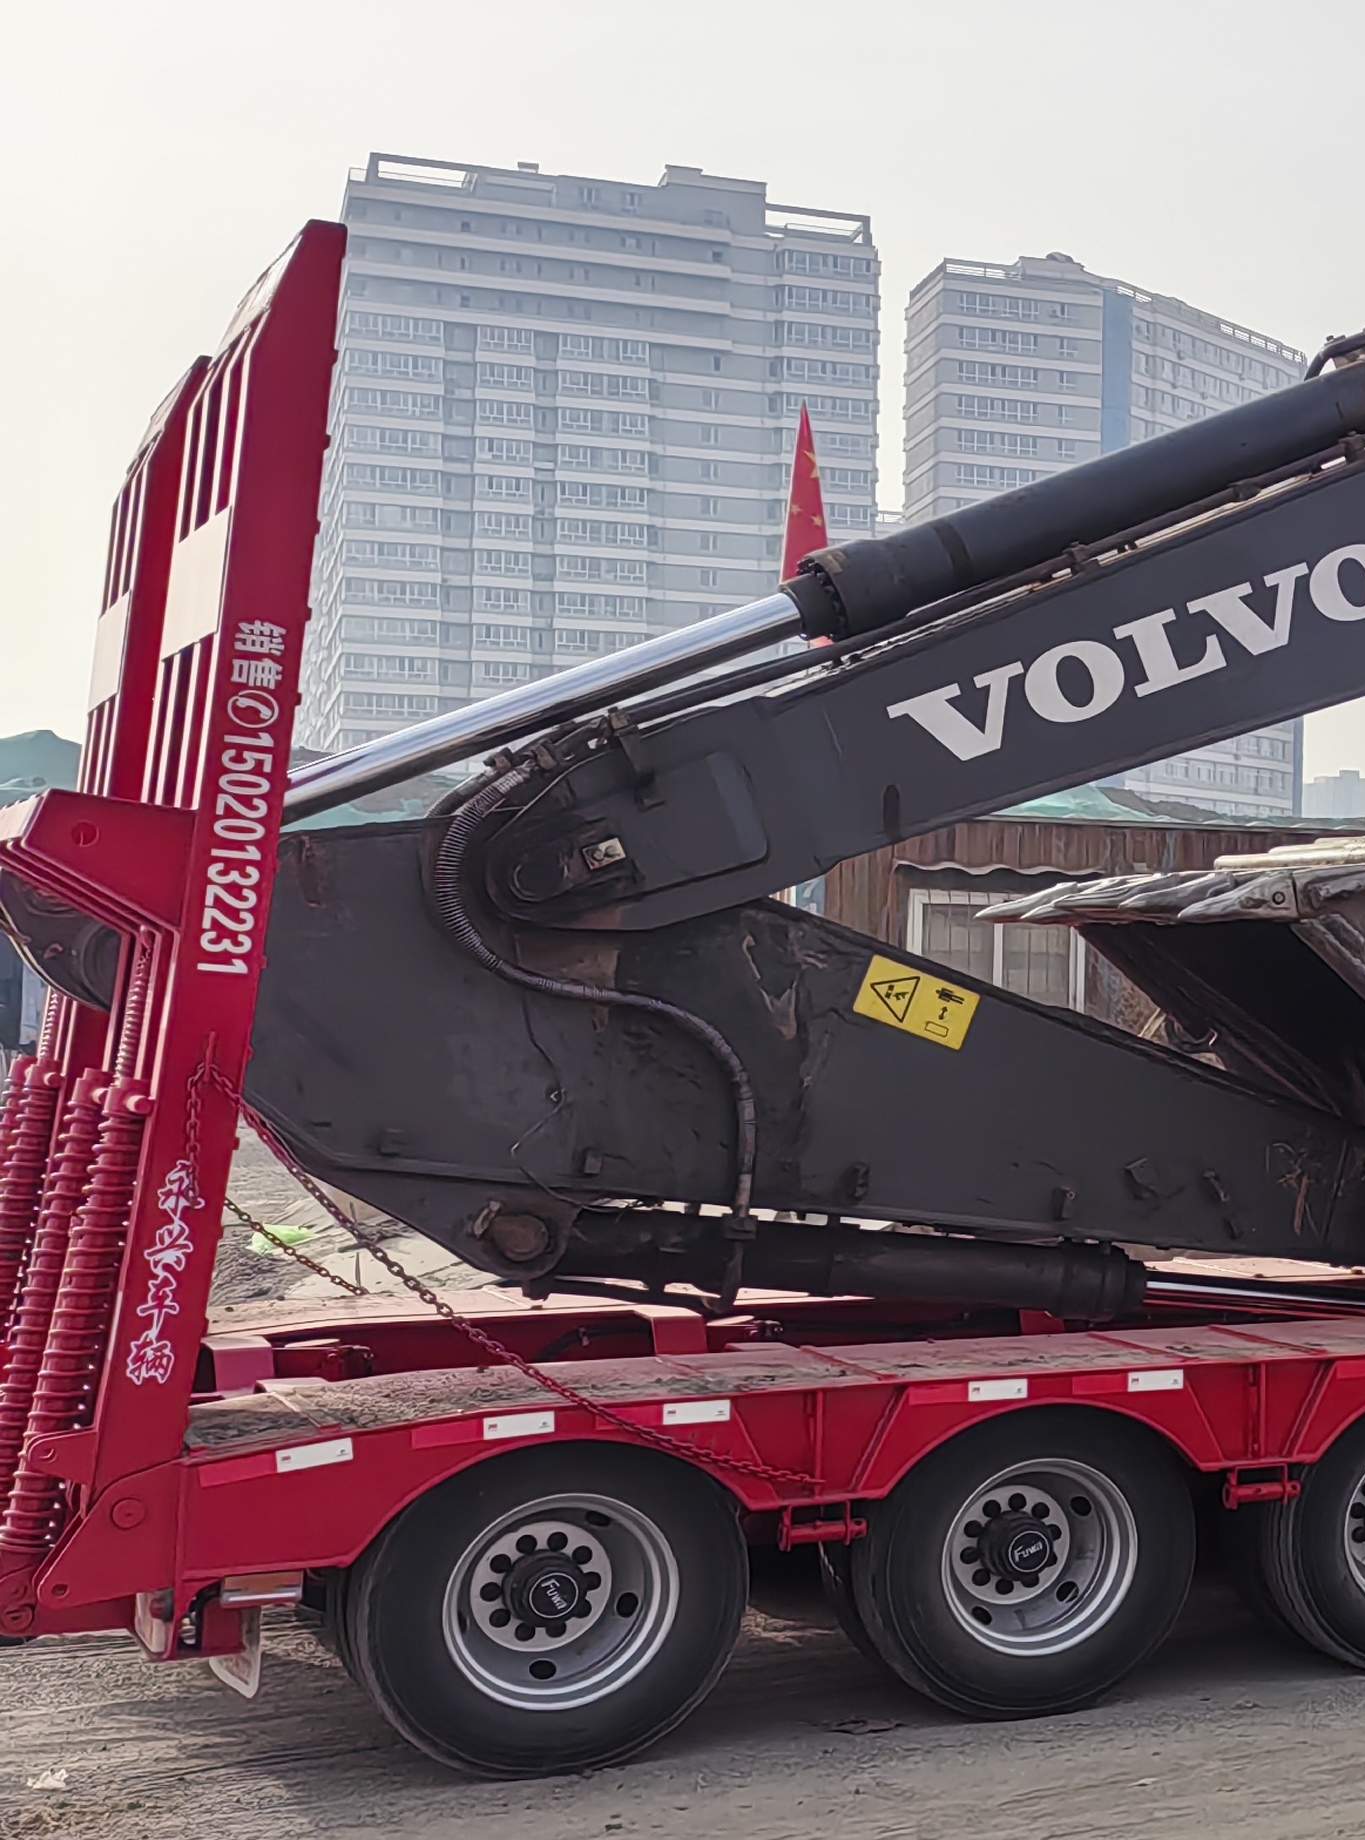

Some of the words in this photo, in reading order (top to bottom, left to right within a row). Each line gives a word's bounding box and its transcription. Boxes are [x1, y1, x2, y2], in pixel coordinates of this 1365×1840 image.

[230, 619, 287, 690] 销售
[196, 731, 275, 975] 15020132231
[126, 1159, 205, 1386] 永兴车辆
